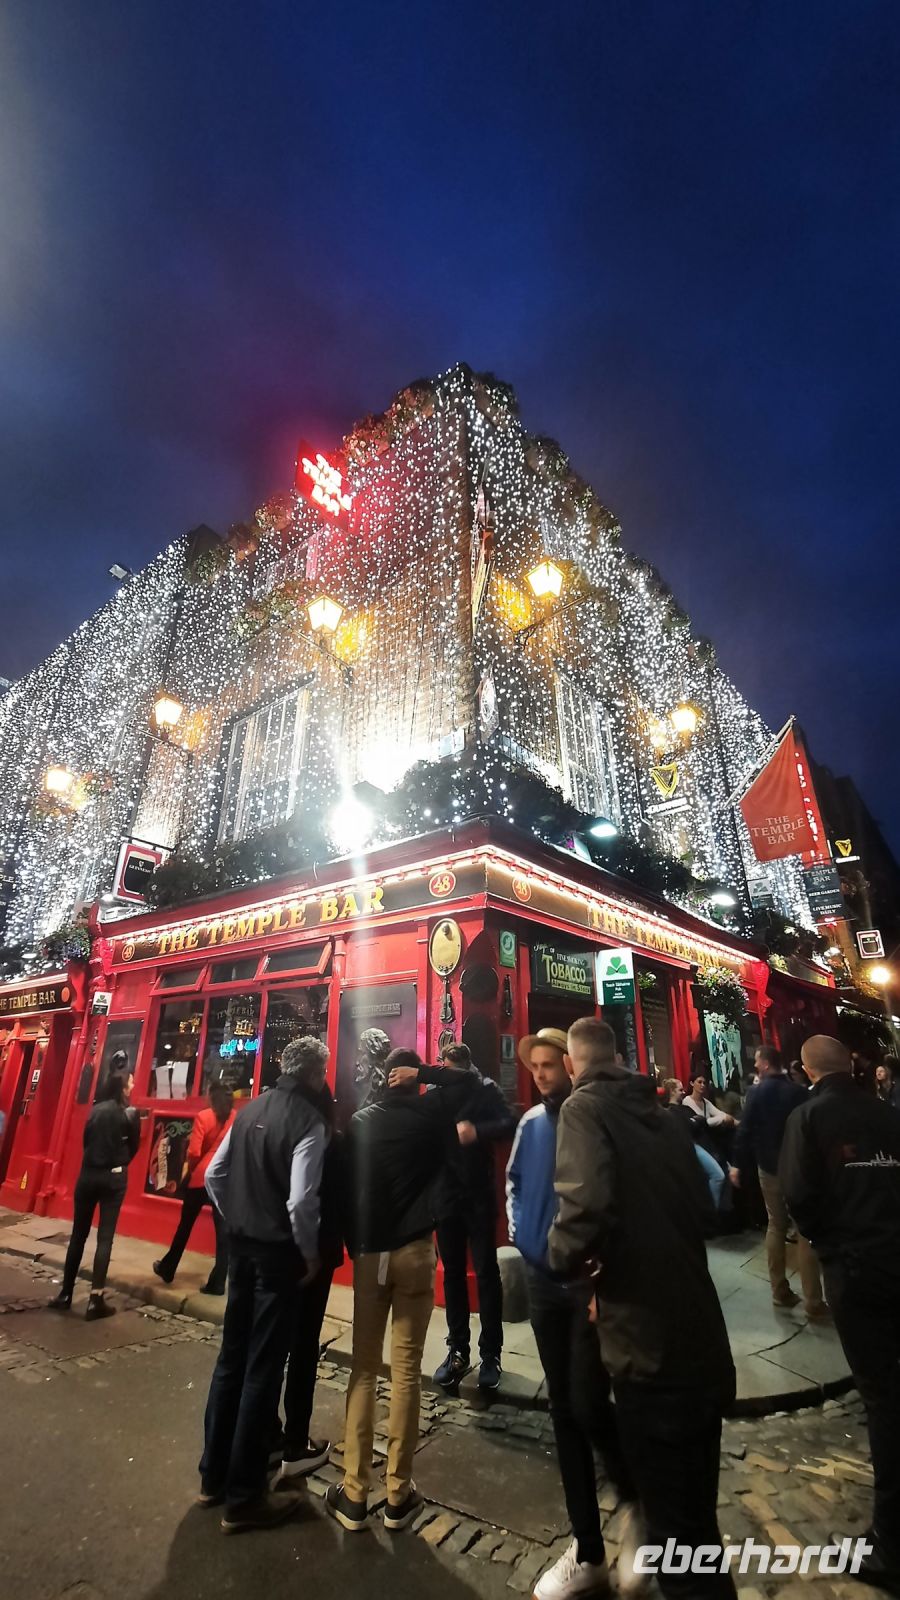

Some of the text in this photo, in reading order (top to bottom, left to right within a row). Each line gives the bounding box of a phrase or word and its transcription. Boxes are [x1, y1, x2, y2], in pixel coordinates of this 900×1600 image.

[751, 817, 805, 837] TEMPLE
[766, 815, 789, 826] THE
[767, 832, 796, 845] BAR
[804, 867, 838, 877] TEMPLE
[813, 875, 831, 883] BAR
[433, 875, 451, 893] 48
[159, 927, 200, 955] THE
[207, 903, 307, 945] TEMPLE
[319, 884, 385, 923] BAR
[592, 909, 629, 938] THE
[635, 926, 693, 960] TEMPLE
[541, 954, 587, 984] TOBACCO
[9, 992, 38, 1010] TEMPLE
[38, 990, 56, 1005] BAR
